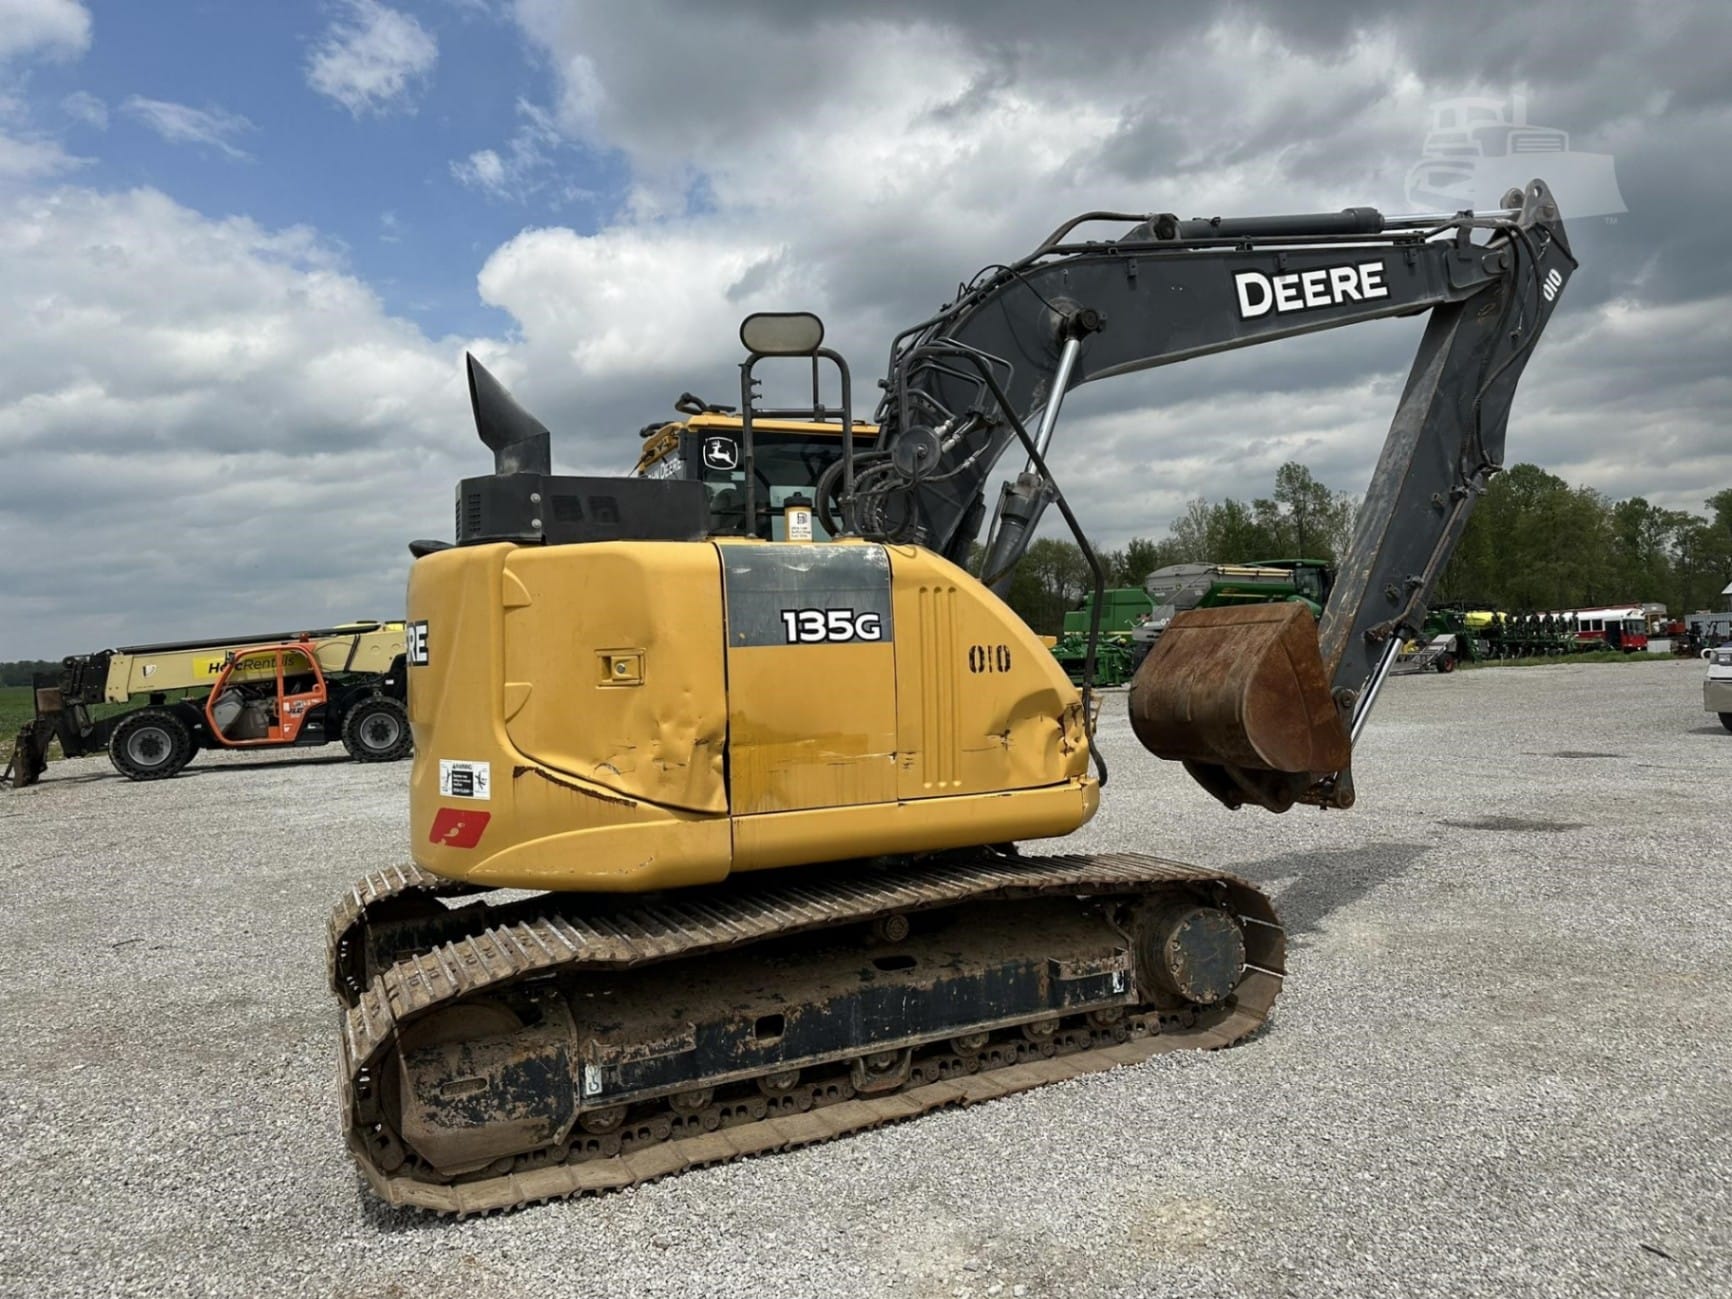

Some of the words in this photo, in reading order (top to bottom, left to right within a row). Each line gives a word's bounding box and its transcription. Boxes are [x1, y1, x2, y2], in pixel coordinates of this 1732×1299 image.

[1234, 261, 1388, 318] DEERE
[782, 609, 882, 644] 135G
[208, 656, 295, 674] HecRentls
[969, 644, 1011, 673] 010
